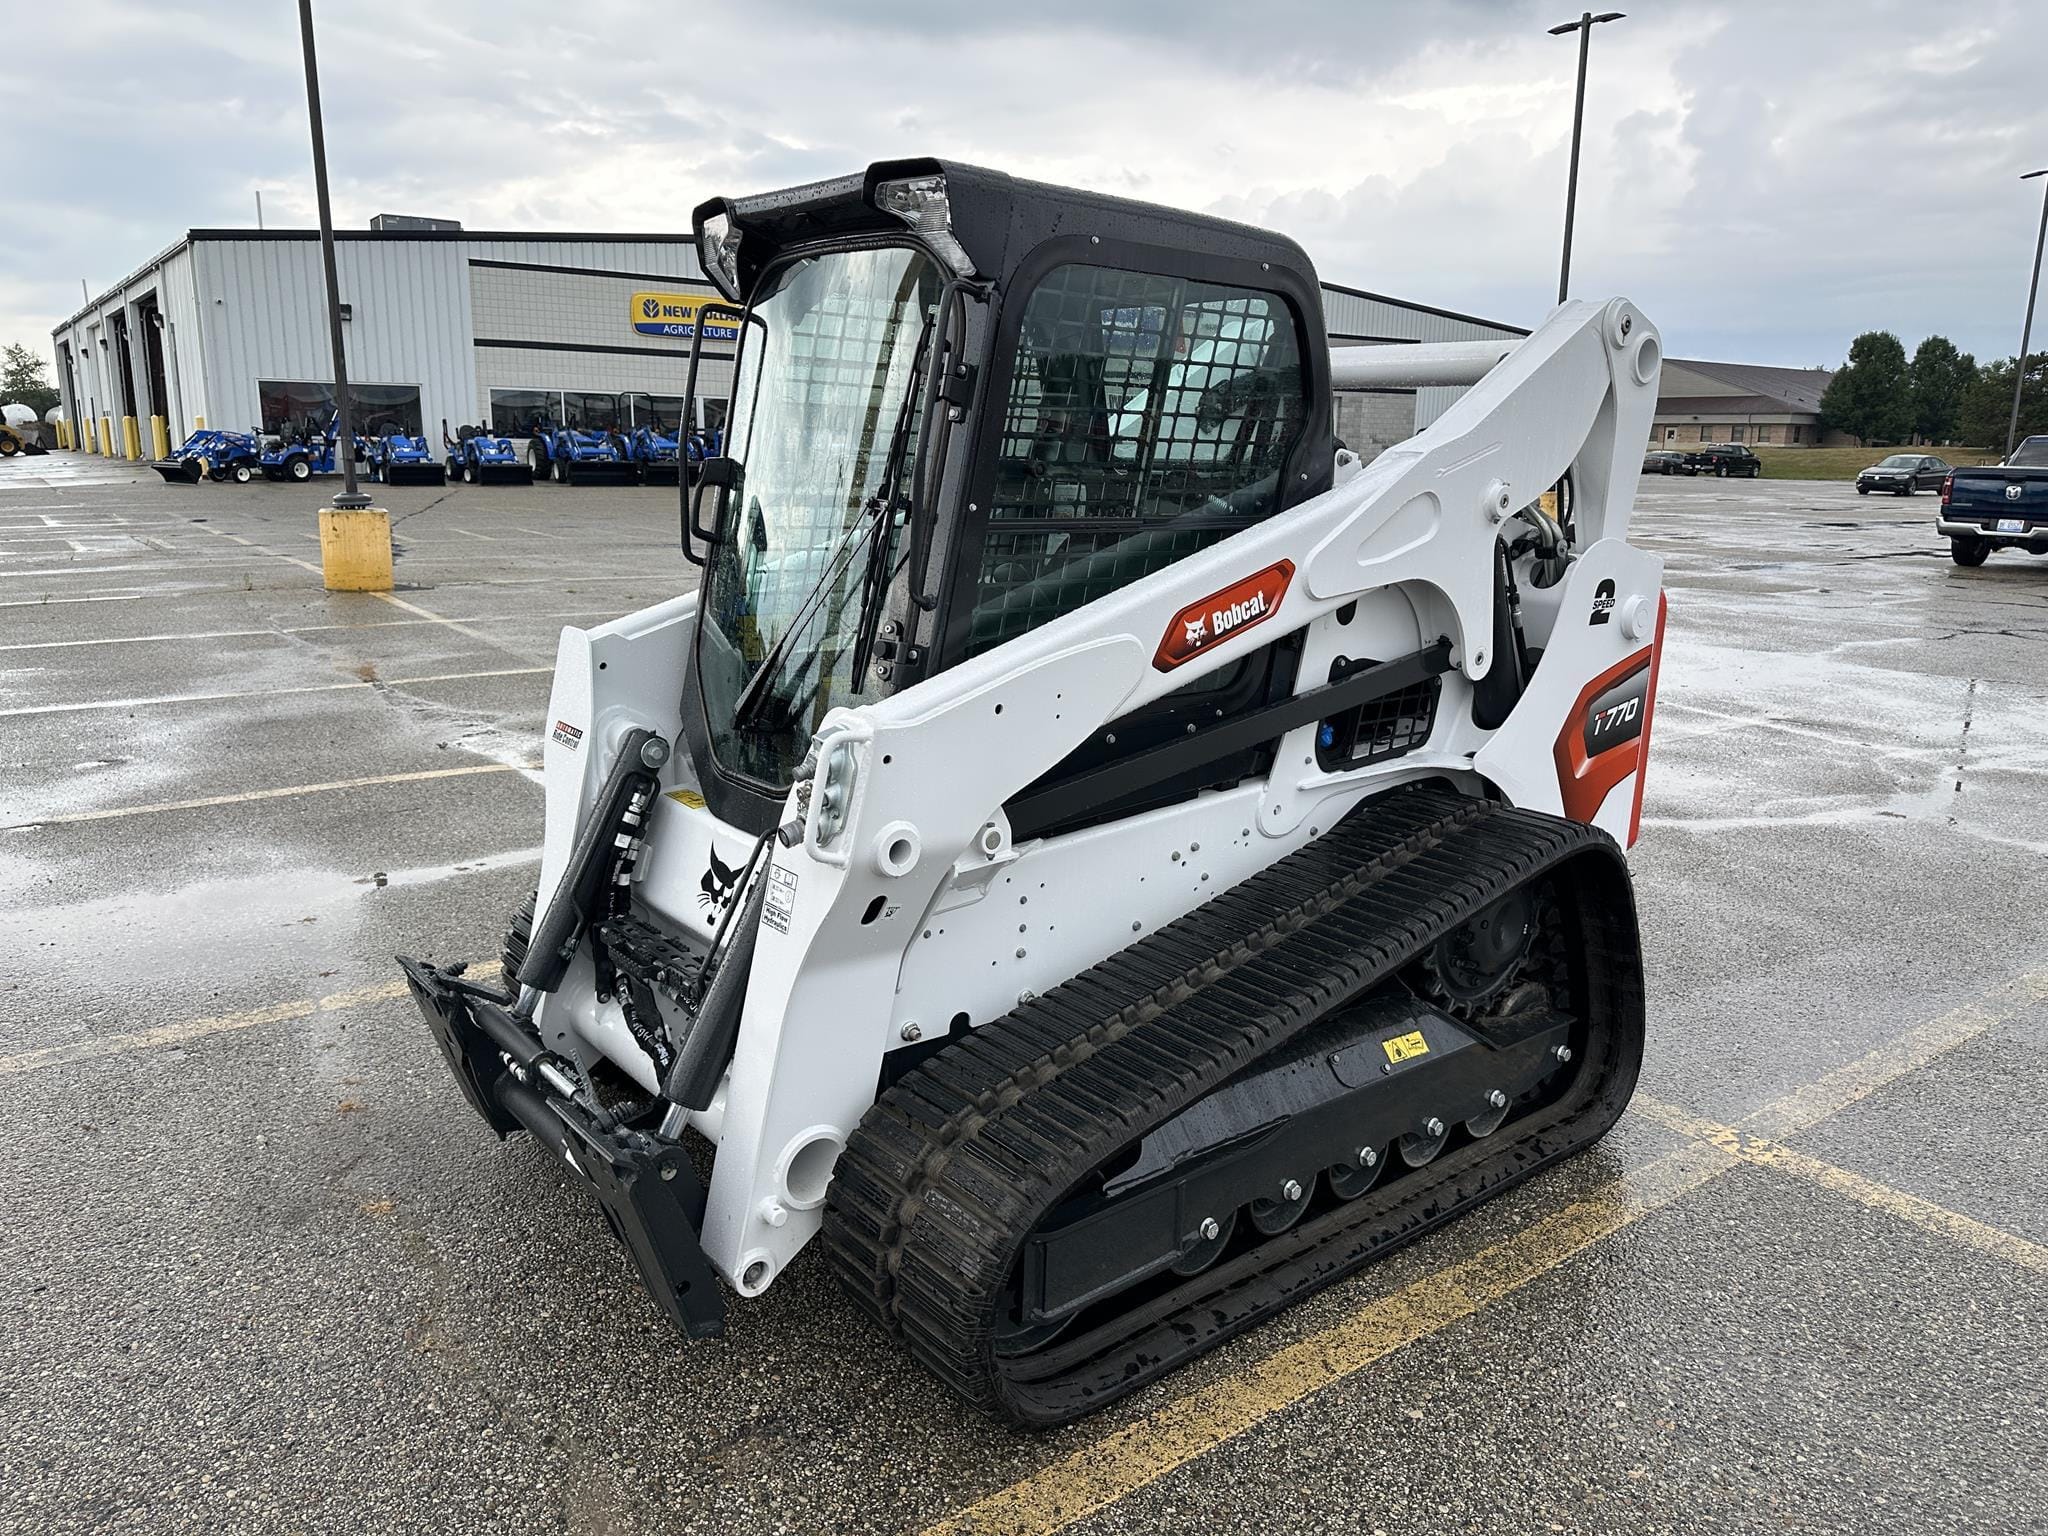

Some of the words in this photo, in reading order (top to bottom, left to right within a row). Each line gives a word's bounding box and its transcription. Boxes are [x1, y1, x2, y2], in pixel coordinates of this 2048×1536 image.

[663, 305, 691, 318] NEW
[663, 325, 733, 338] AGRICLTURE
[1592, 598, 1616, 610] SPEED
[1212, 590, 1266, 636] Bobcat
